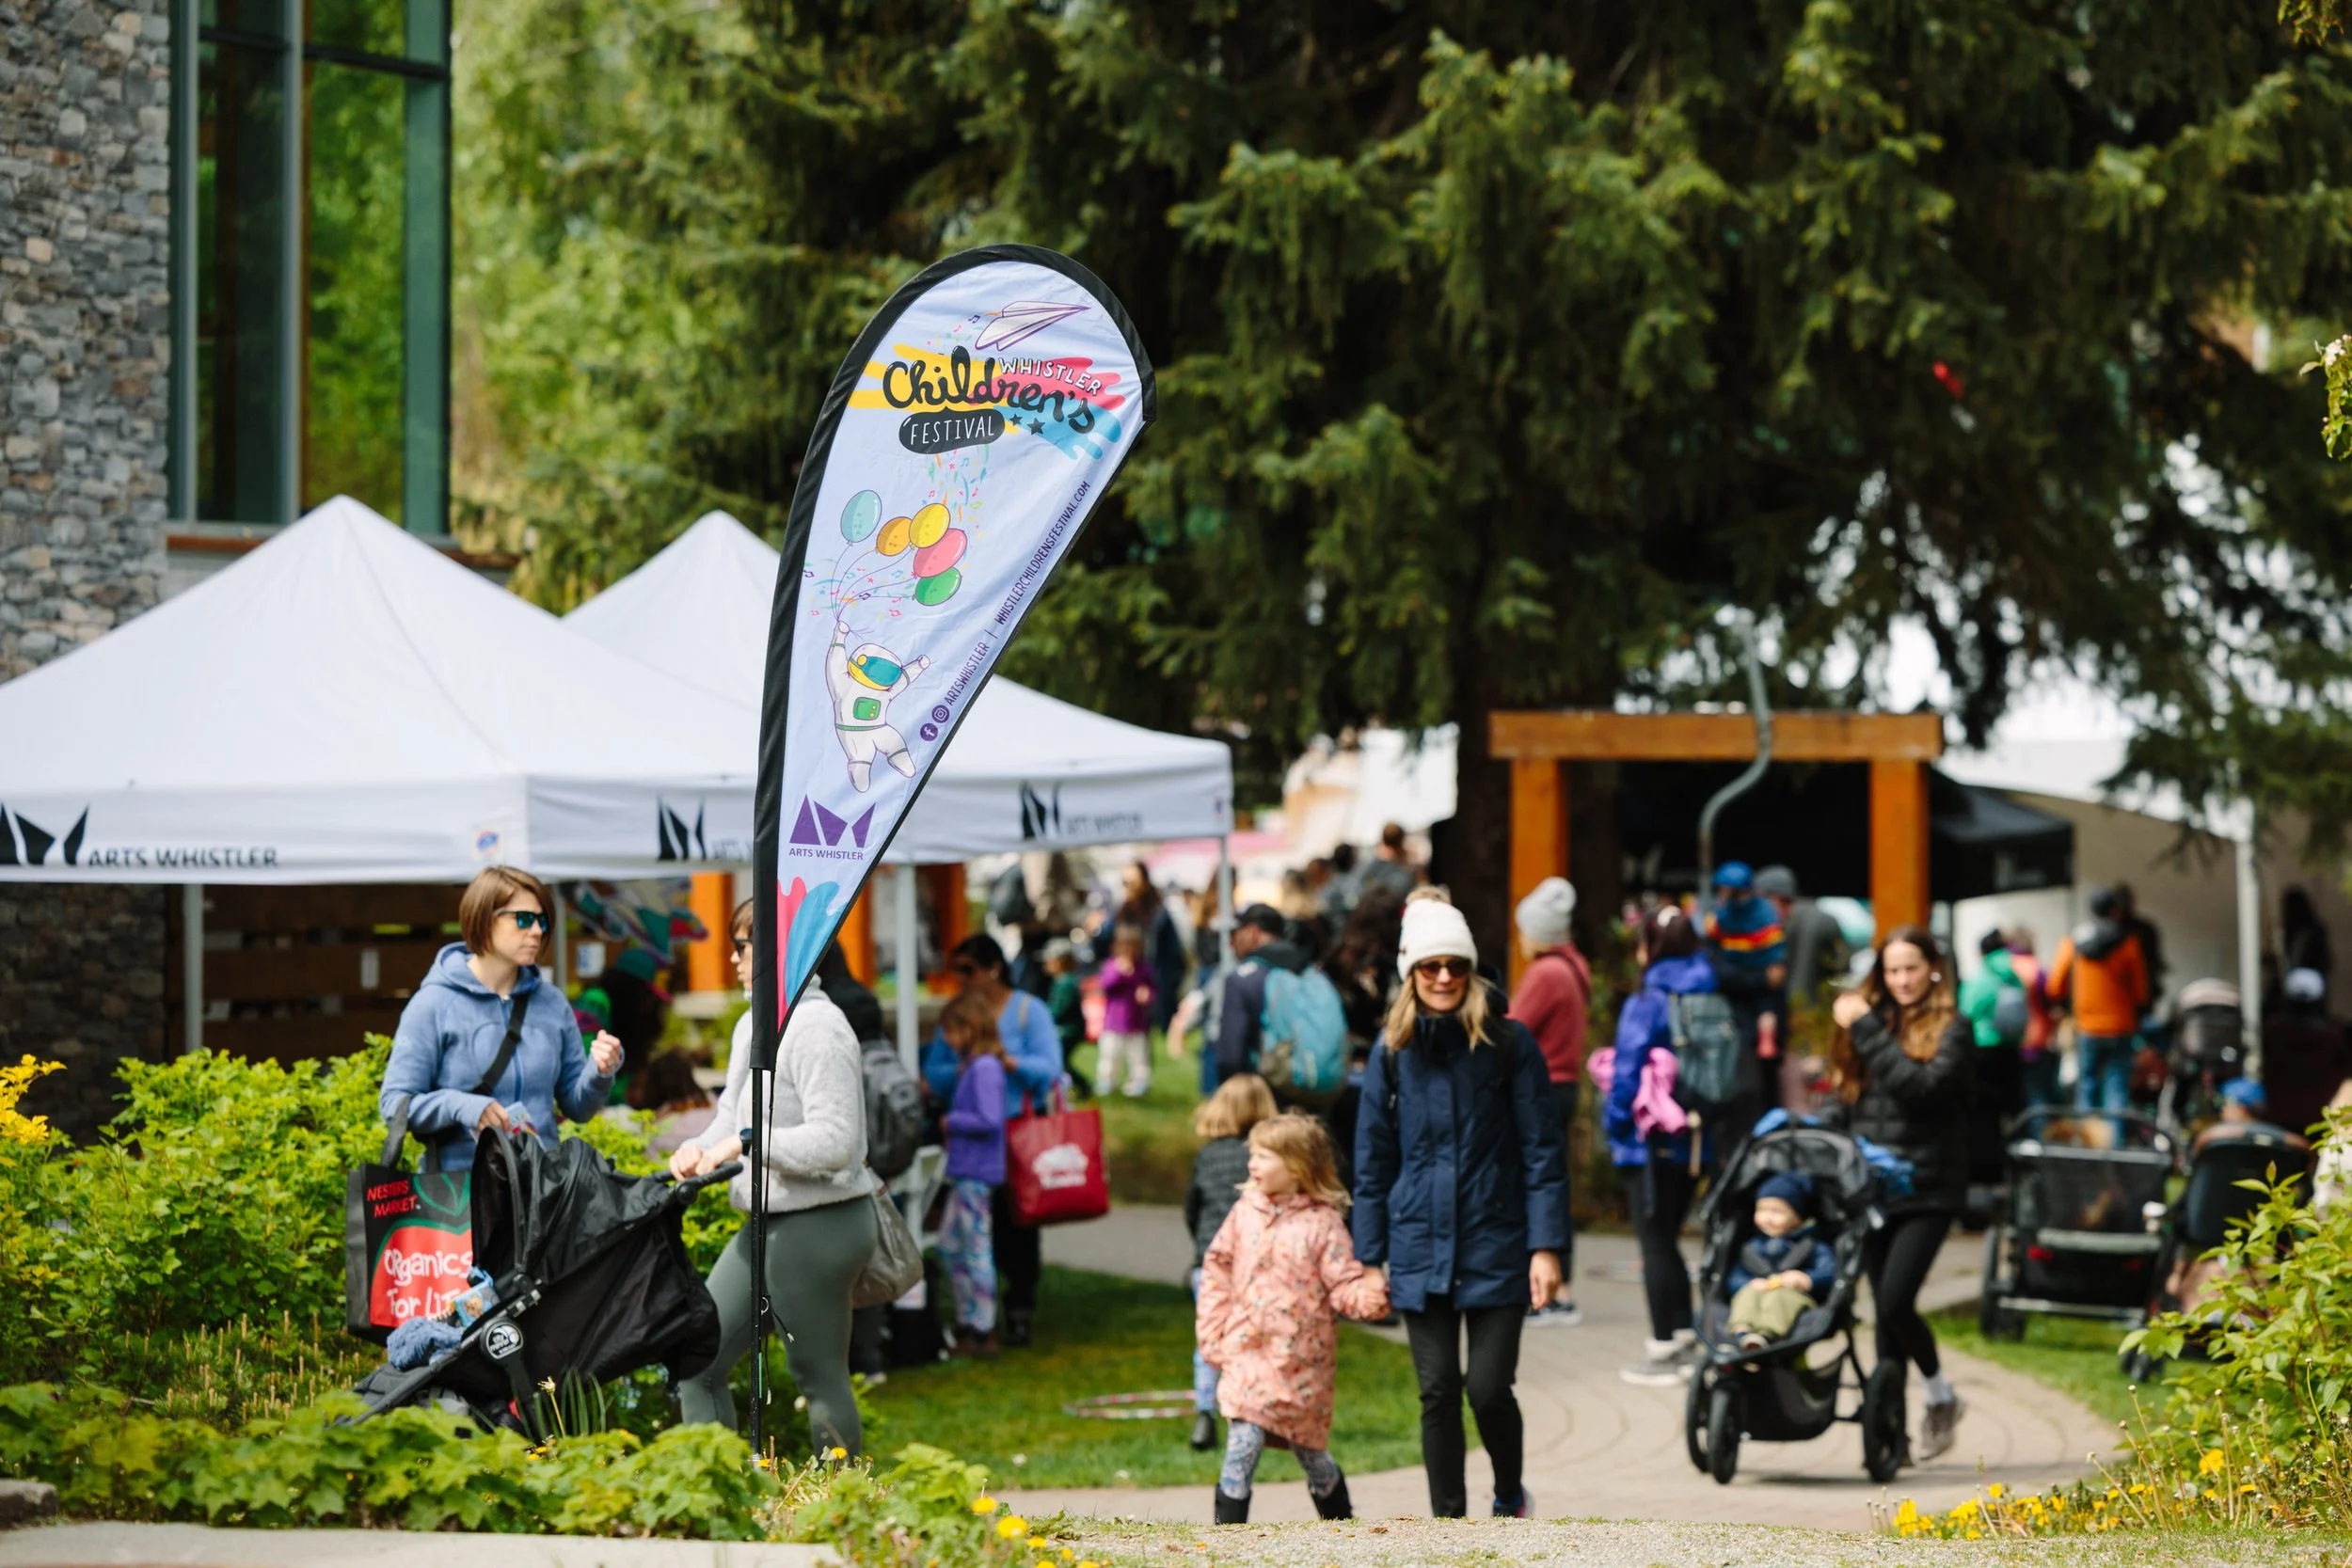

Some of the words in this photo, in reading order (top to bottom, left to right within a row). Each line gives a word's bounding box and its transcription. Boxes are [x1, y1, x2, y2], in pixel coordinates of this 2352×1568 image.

[882, 345, 1096, 435] Children's
[998, 356, 1104, 397] WHISTLER
[910, 415, 995, 446] FESTIVAL
[944, 641, 990, 706] ARTSWHISTLER
[993, 481, 1090, 626] WHISTLERCHILDRENSFESTIVAL.COM
[88, 847, 148, 868] ARTS
[155, 847, 278, 869] WHISTLER
[788, 848, 814, 858] ARTS
[816, 850, 864, 861] WHISTLER
[373, 1194, 418, 1218] MARKET
